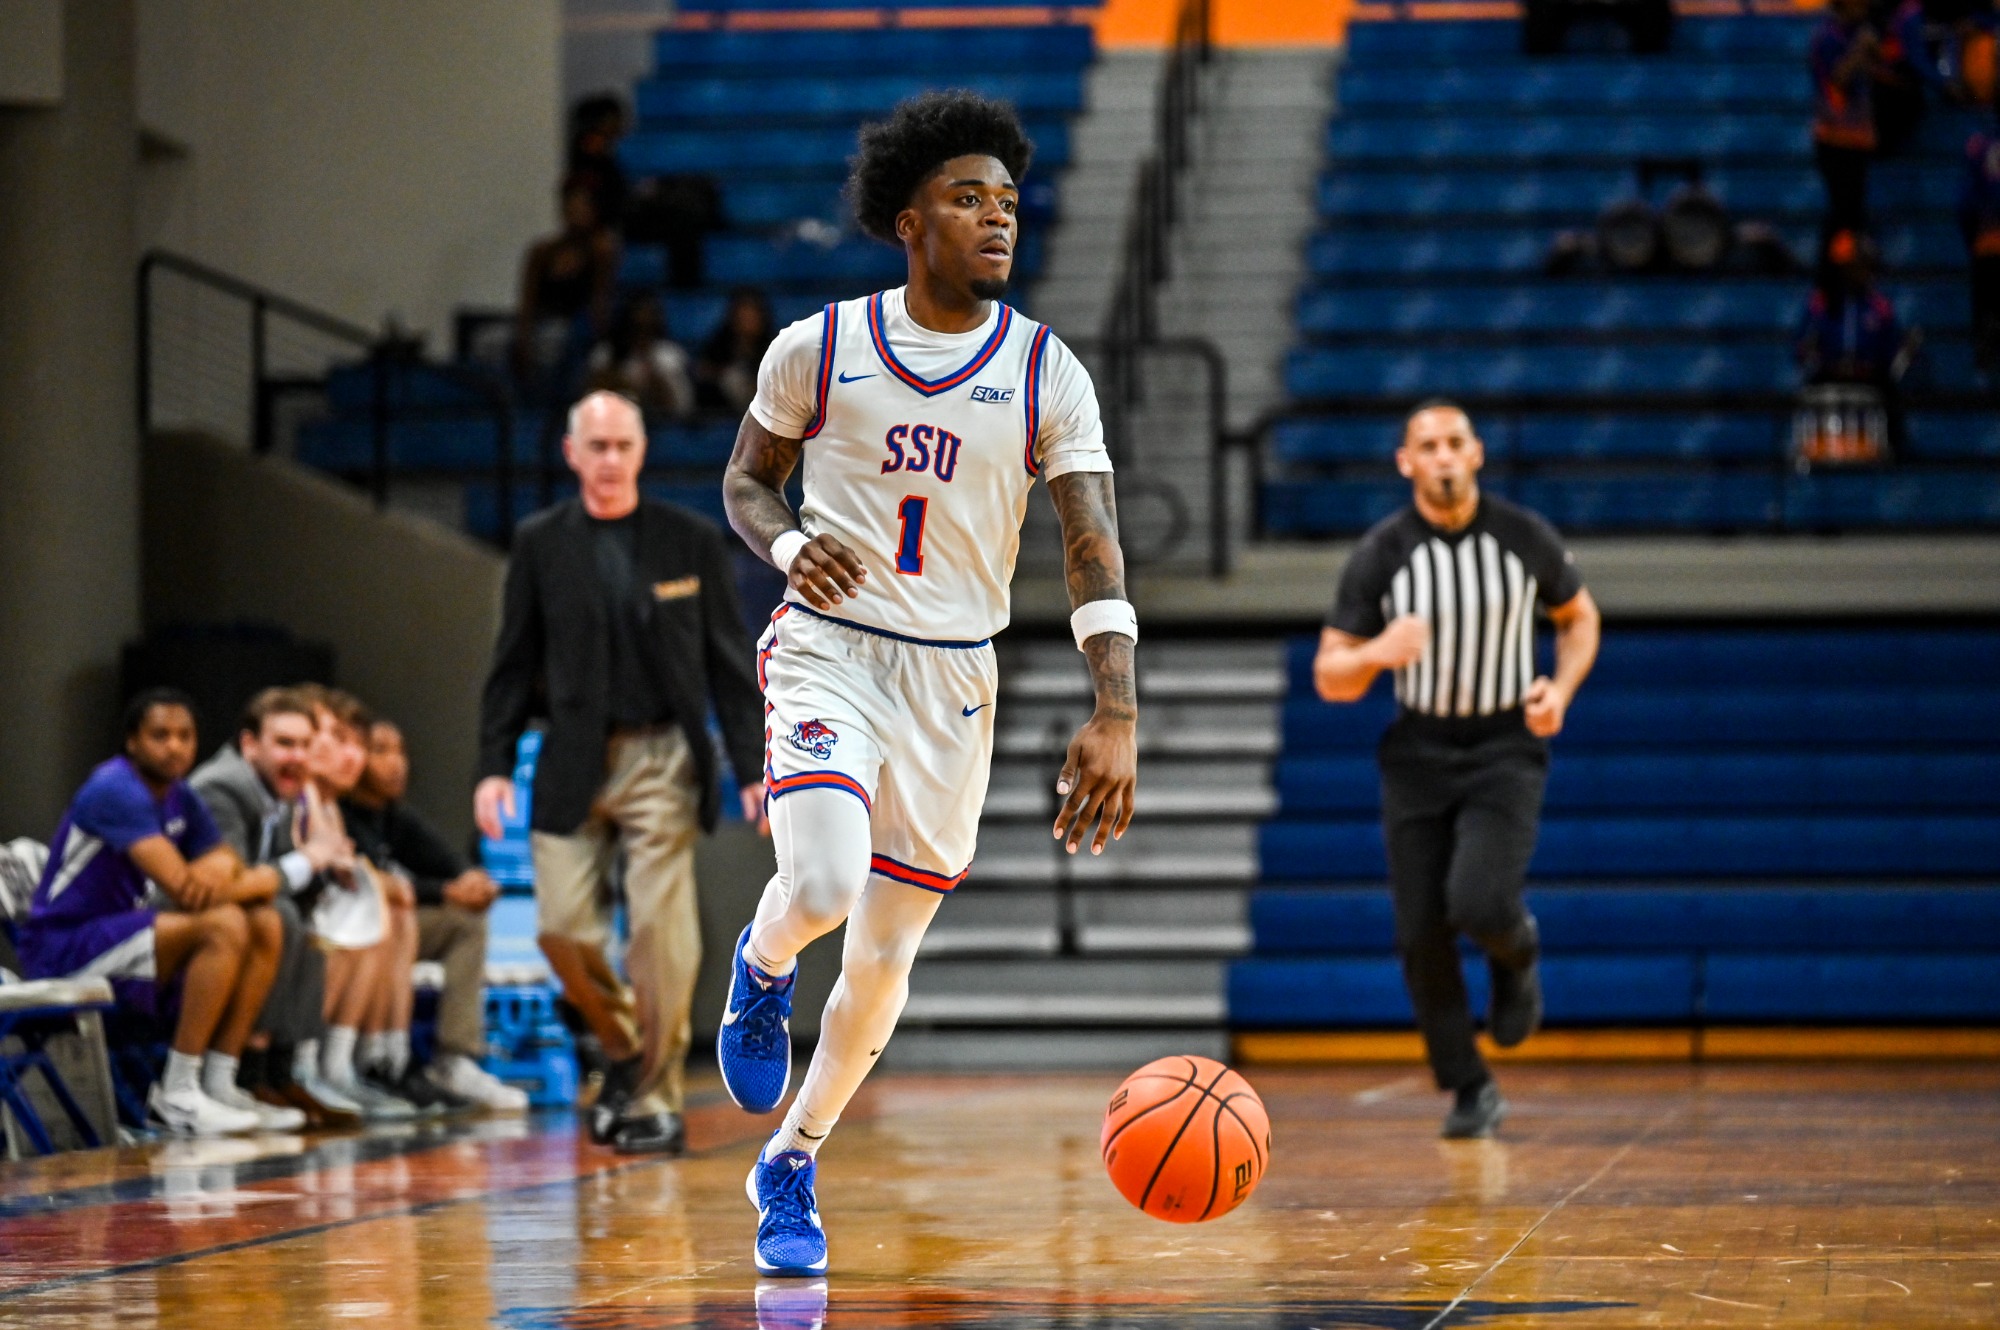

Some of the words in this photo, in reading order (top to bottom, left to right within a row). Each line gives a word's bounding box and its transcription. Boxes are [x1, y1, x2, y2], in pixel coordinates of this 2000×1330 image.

[971, 386, 1014, 402] SIAC
[881, 424, 961, 482] SSU
[895, 494, 928, 576] 1
